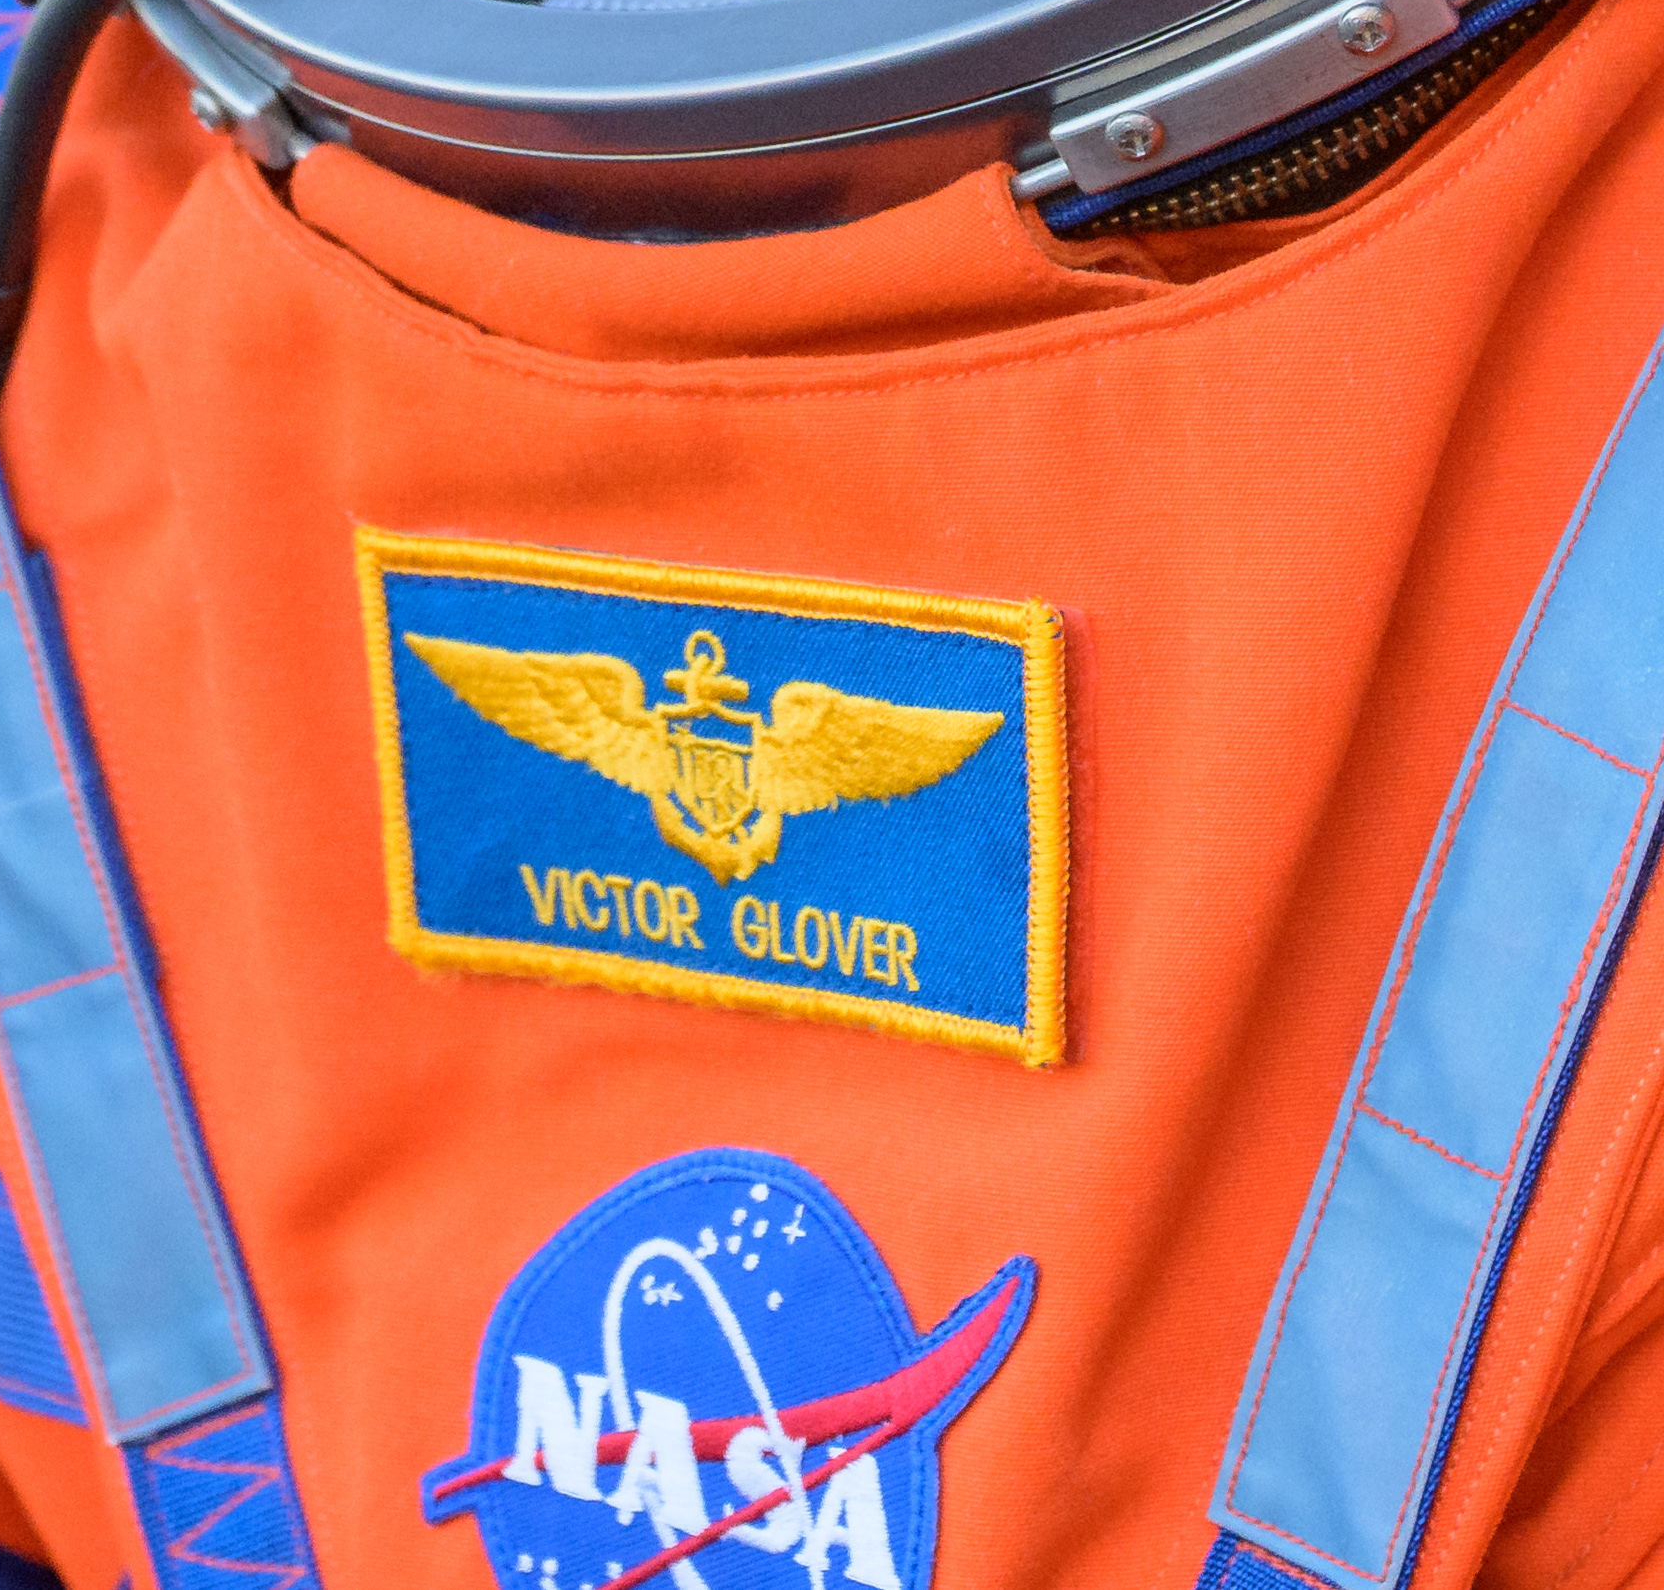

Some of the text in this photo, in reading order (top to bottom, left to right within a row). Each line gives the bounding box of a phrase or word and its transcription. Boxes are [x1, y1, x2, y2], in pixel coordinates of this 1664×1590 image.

[521, 864, 921, 992] VICTOR GLOVER
[502, 1354, 902, 1590] NASA
